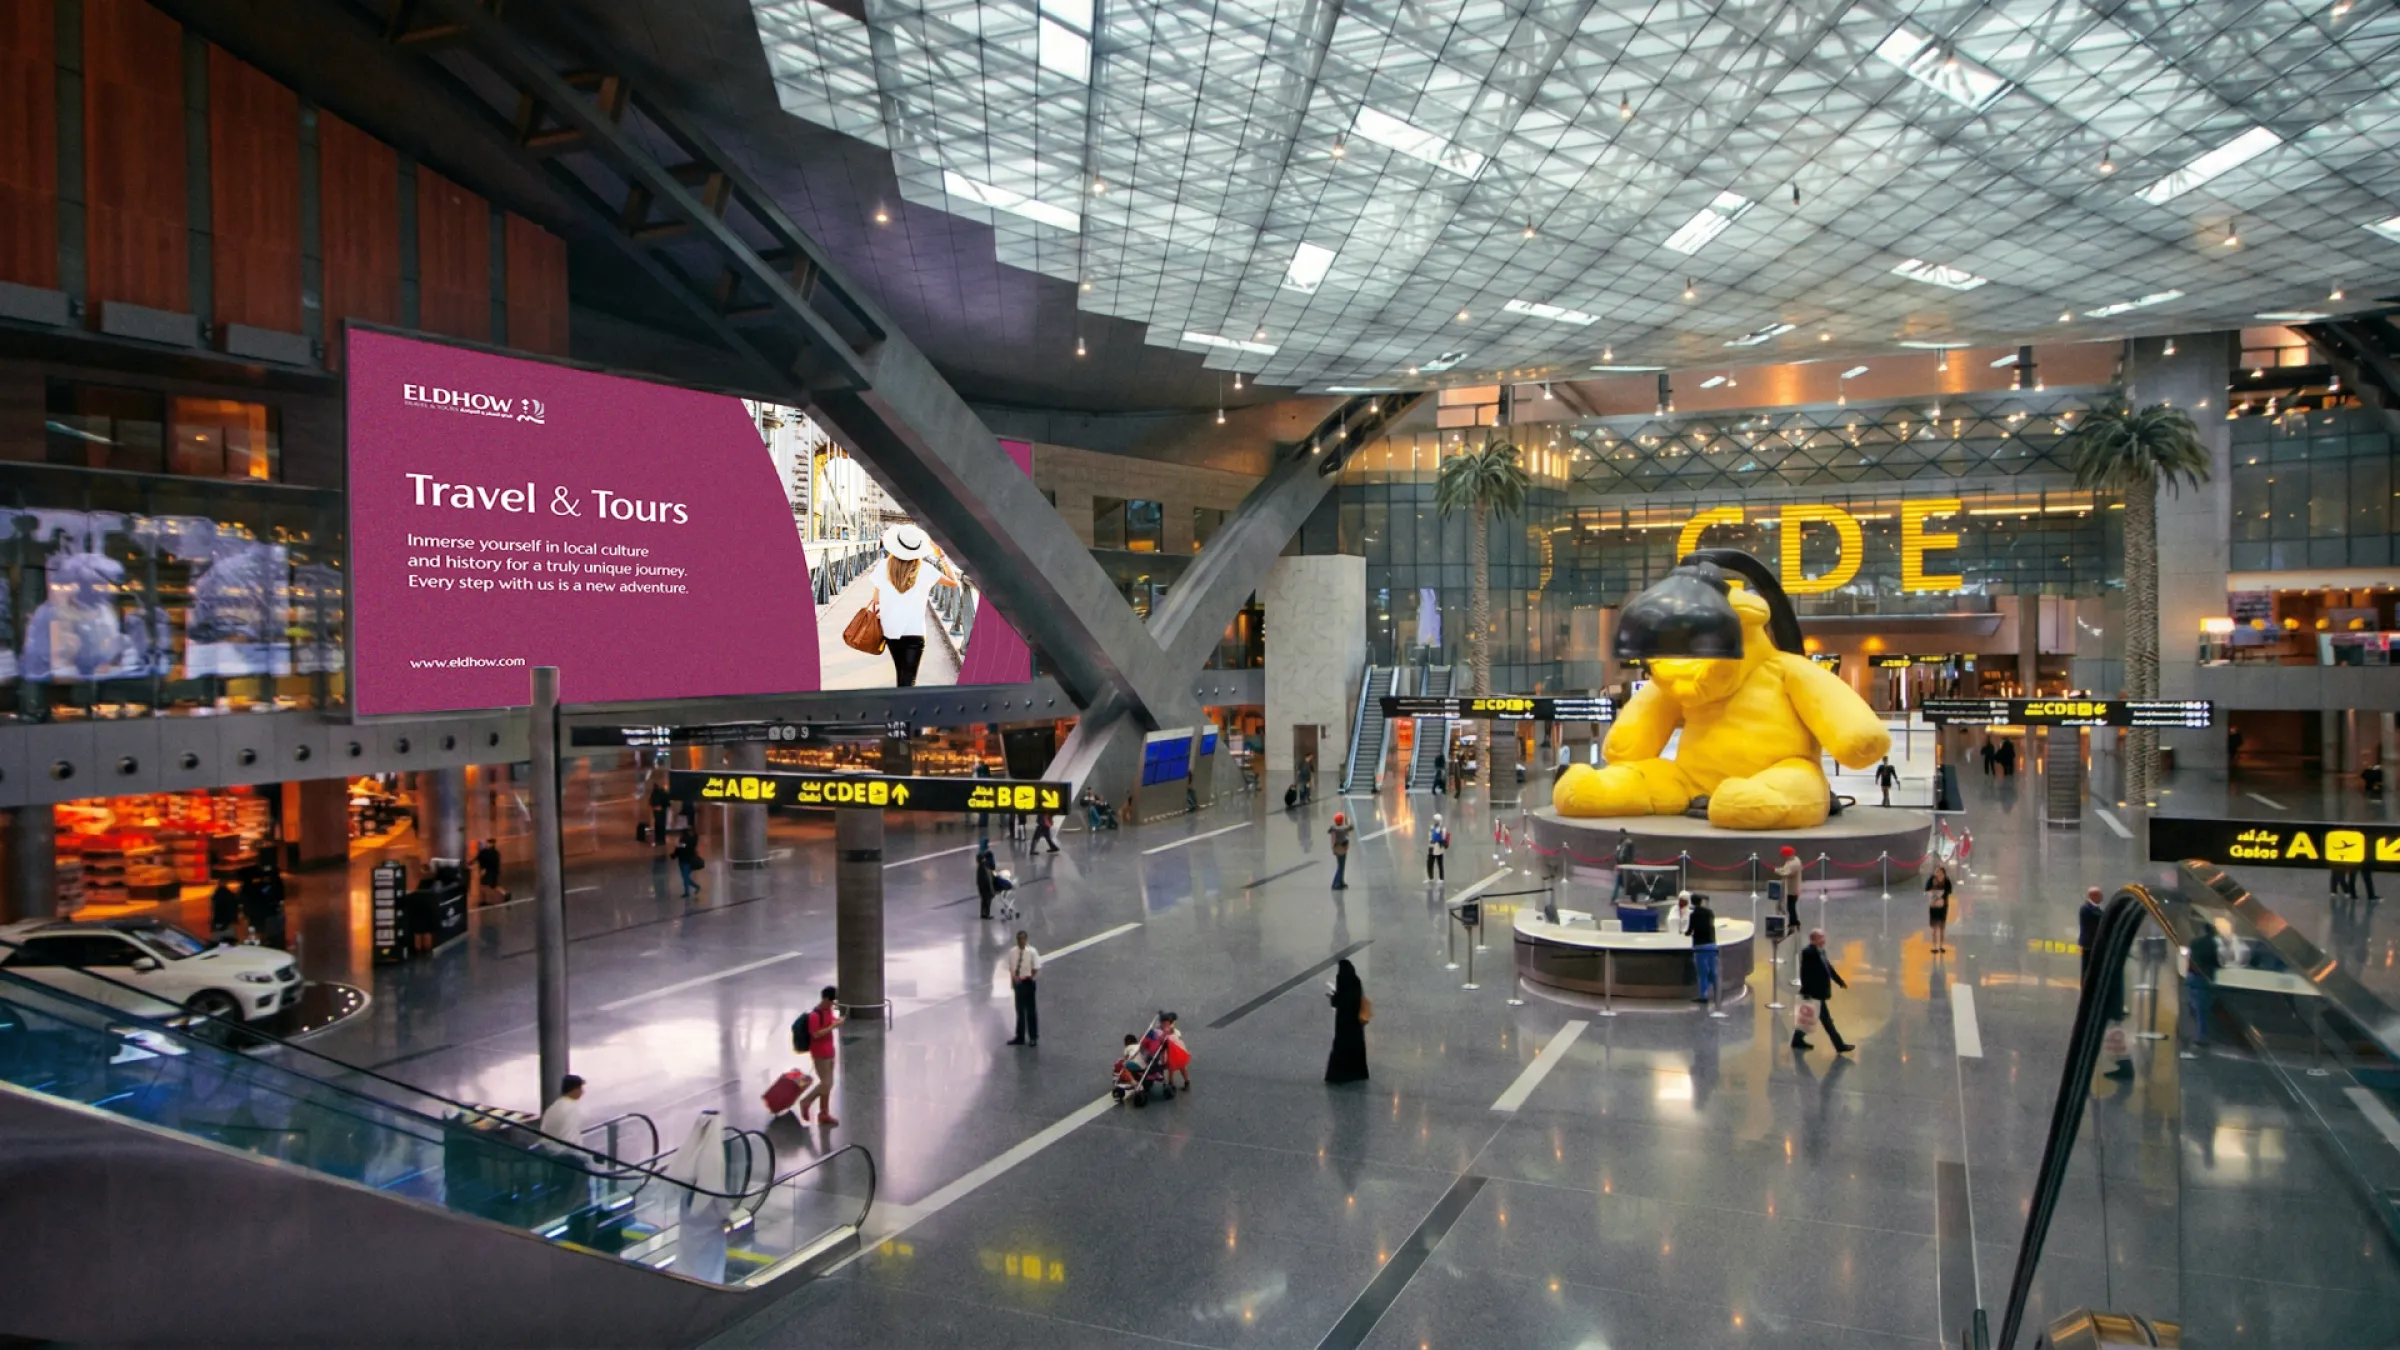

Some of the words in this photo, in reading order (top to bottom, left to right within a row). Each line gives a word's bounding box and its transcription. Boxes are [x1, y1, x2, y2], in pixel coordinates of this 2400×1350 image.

[404, 384, 513, 413] ELDHOW
[406, 473, 535, 513] Travel
[551, 486, 581, 516] &
[591, 490, 688, 524] Tours
[408, 534, 474, 549] Inmerse
[480, 540, 541, 552] yourself
[546, 541, 559, 552] in
[564, 542, 596, 554] local
[601, 545, 649, 557] culture
[408, 555, 440, 567] and
[446, 555, 501, 572] history
[507, 558, 529, 570] for
[533, 562, 541, 571] a
[547, 560, 580, 575] truly
[585, 562, 631, 576] unique
[635, 564, 687, 578] journey.
[409, 575, 454, 590] Every
[460, 577, 494, 592] step
[499, 578, 533, 590] with
[538, 581, 554, 590] us
[559, 579, 569, 591] is
[573, 582, 581, 591] a
[586, 582, 615, 592] new
[620, 581, 688, 593] adventure.
[410, 657, 525, 668] www.eldhow.com
[2044, 702, 2077, 715] CDE
[725, 779, 740, 797] A
[823, 782, 866, 802] CDE
[998, 786, 1011, 806] B
[2285, 831, 2319, 859] A
